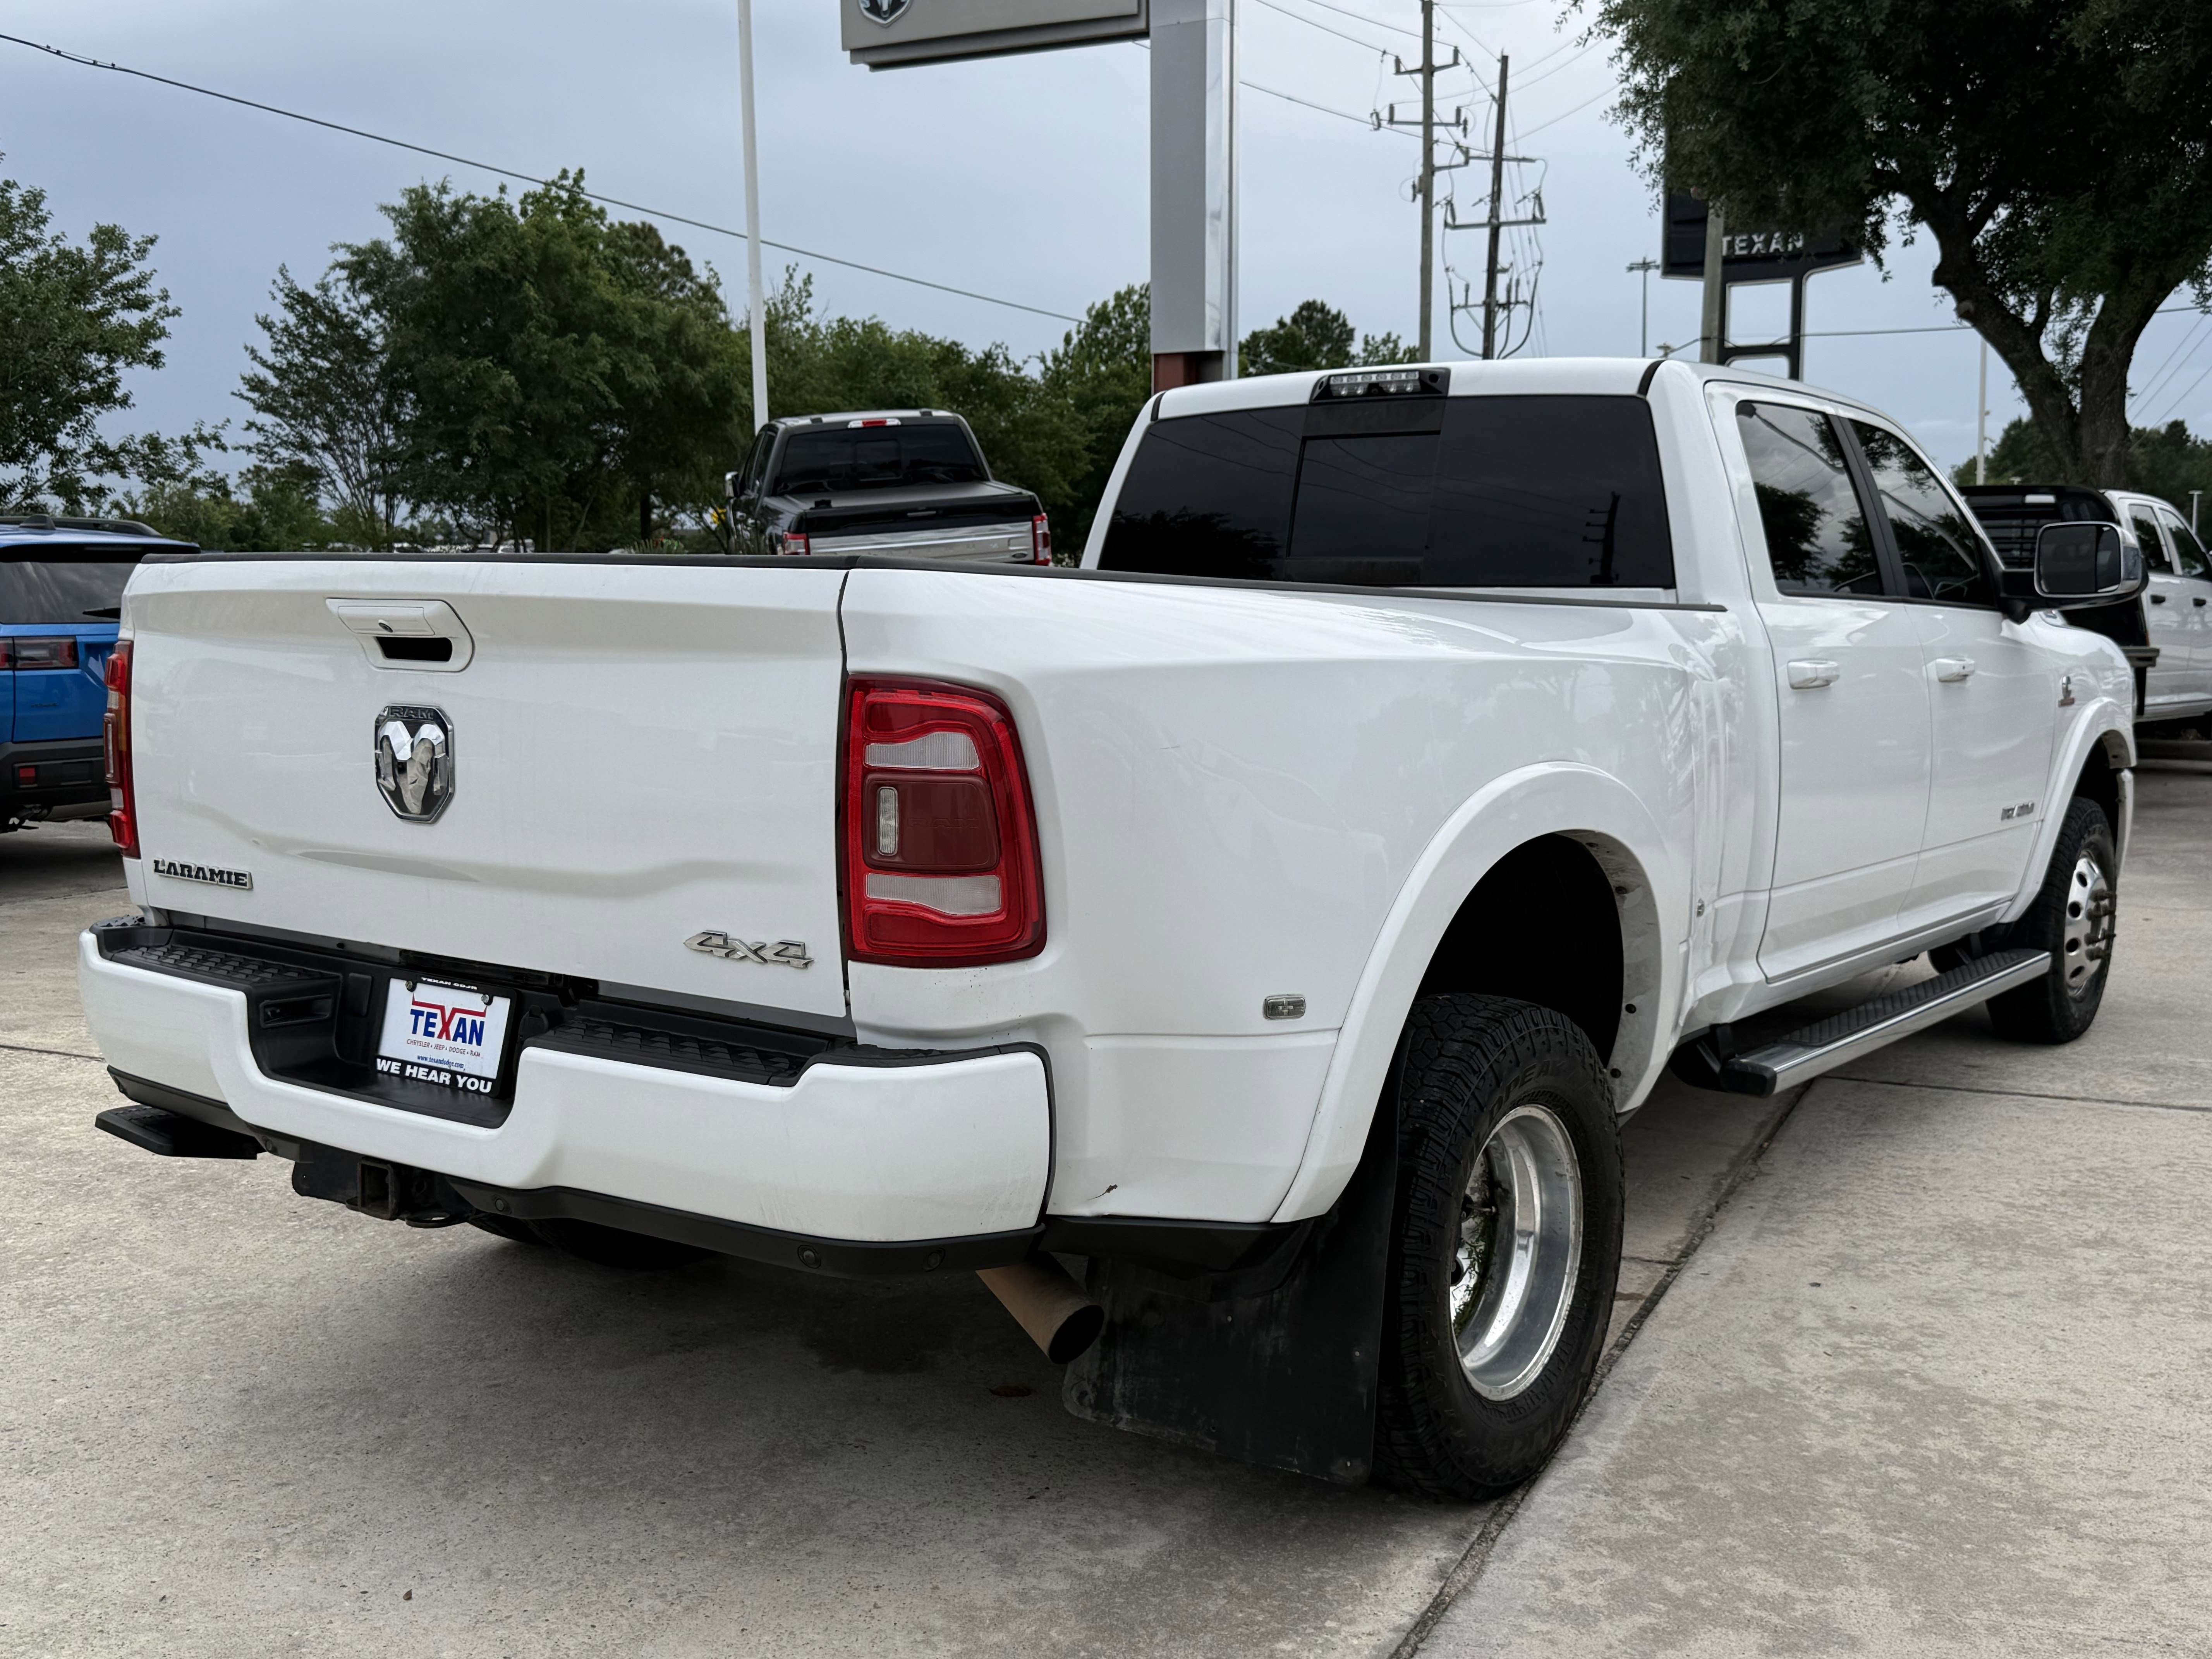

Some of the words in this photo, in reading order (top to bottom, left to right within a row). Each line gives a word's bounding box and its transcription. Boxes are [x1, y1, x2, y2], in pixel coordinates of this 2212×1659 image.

[1722, 231, 1804, 256] TEXAN
[388, 706, 433, 719] RAM
[153, 857, 252, 888] LARAMIE
[421, 977, 451, 985] TEXAN
[410, 993, 487, 1046] TEXAN
[407, 1039, 430, 1048] CHRYSLER
[449, 1046, 466, 1055] DODGE
[417, 1055, 464, 1068] www.texandodge.com
[376, 1058, 402, 1074] WE
[405, 1065, 451, 1085] HEAR
[456, 1075, 492, 1093] YOU
